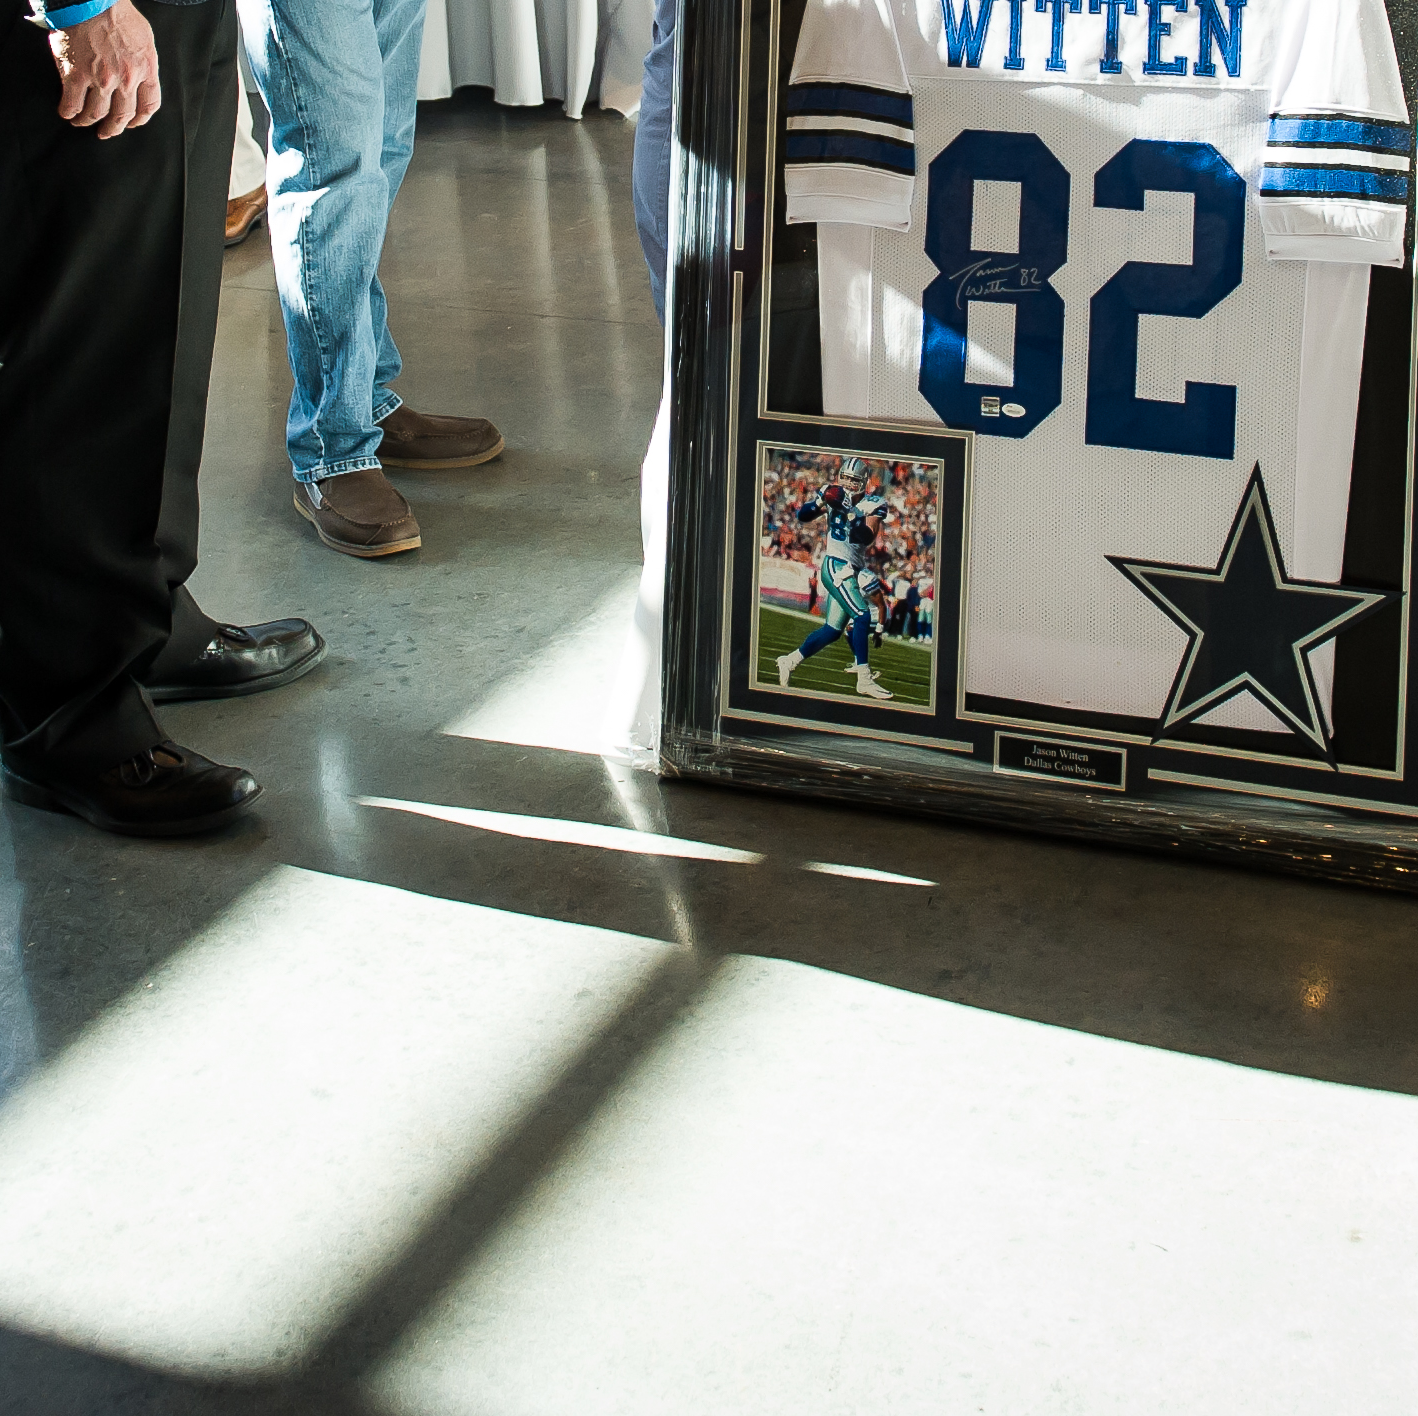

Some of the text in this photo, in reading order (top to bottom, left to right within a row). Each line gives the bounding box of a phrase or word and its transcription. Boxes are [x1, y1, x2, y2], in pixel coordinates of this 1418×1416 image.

[1021, 268, 1042, 286] 82
[918, 128, 1247, 461] 82
[1032, 745, 1089, 762] Jason Witten
[1024, 756, 1096, 777] Dallas Cowboys
